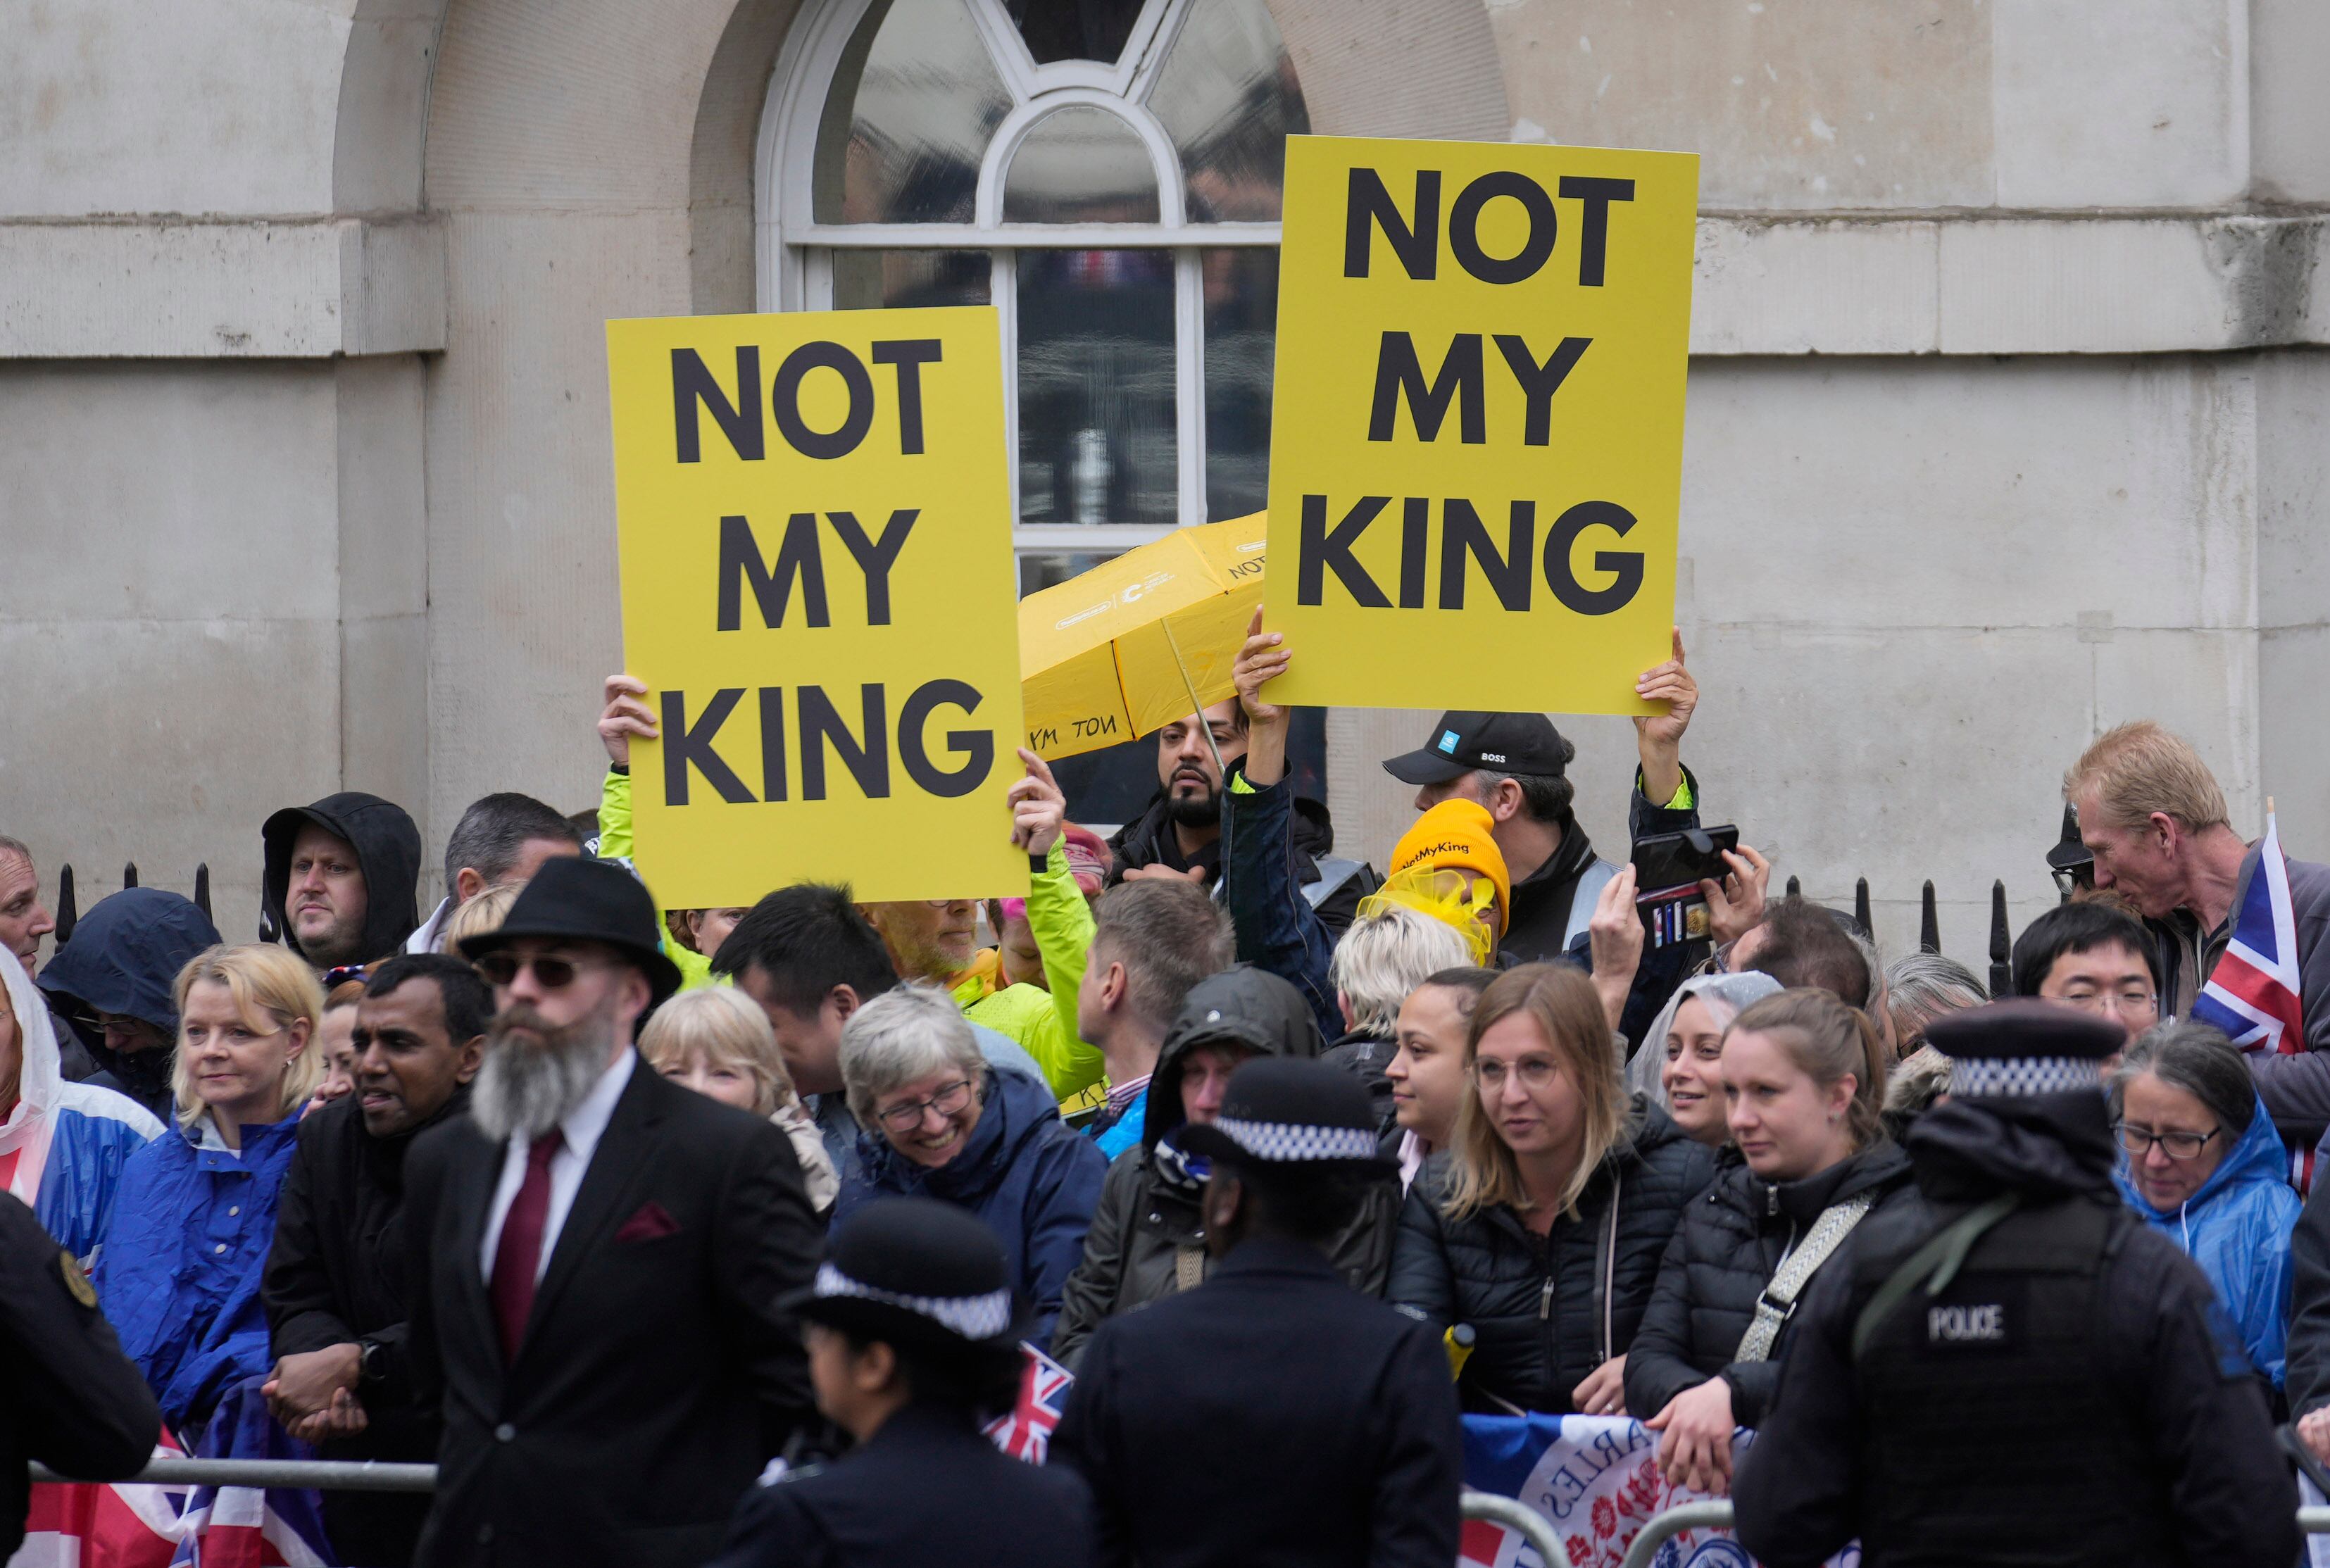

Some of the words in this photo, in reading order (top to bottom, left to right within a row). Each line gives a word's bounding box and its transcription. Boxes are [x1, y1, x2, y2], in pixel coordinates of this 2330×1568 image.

[1344, 168, 1636, 287] NOT
[672, 339, 943, 463] NOT
[1368, 331, 1594, 446] MY
[718, 510, 921, 632] MY
[1298, 495, 1645, 616] KING
[661, 679, 994, 806] KING
[1481, 752, 1506, 763] BOSS
[1400, 841, 1469, 869] NotMyKing
[1928, 1305, 2005, 1341] POLICE
